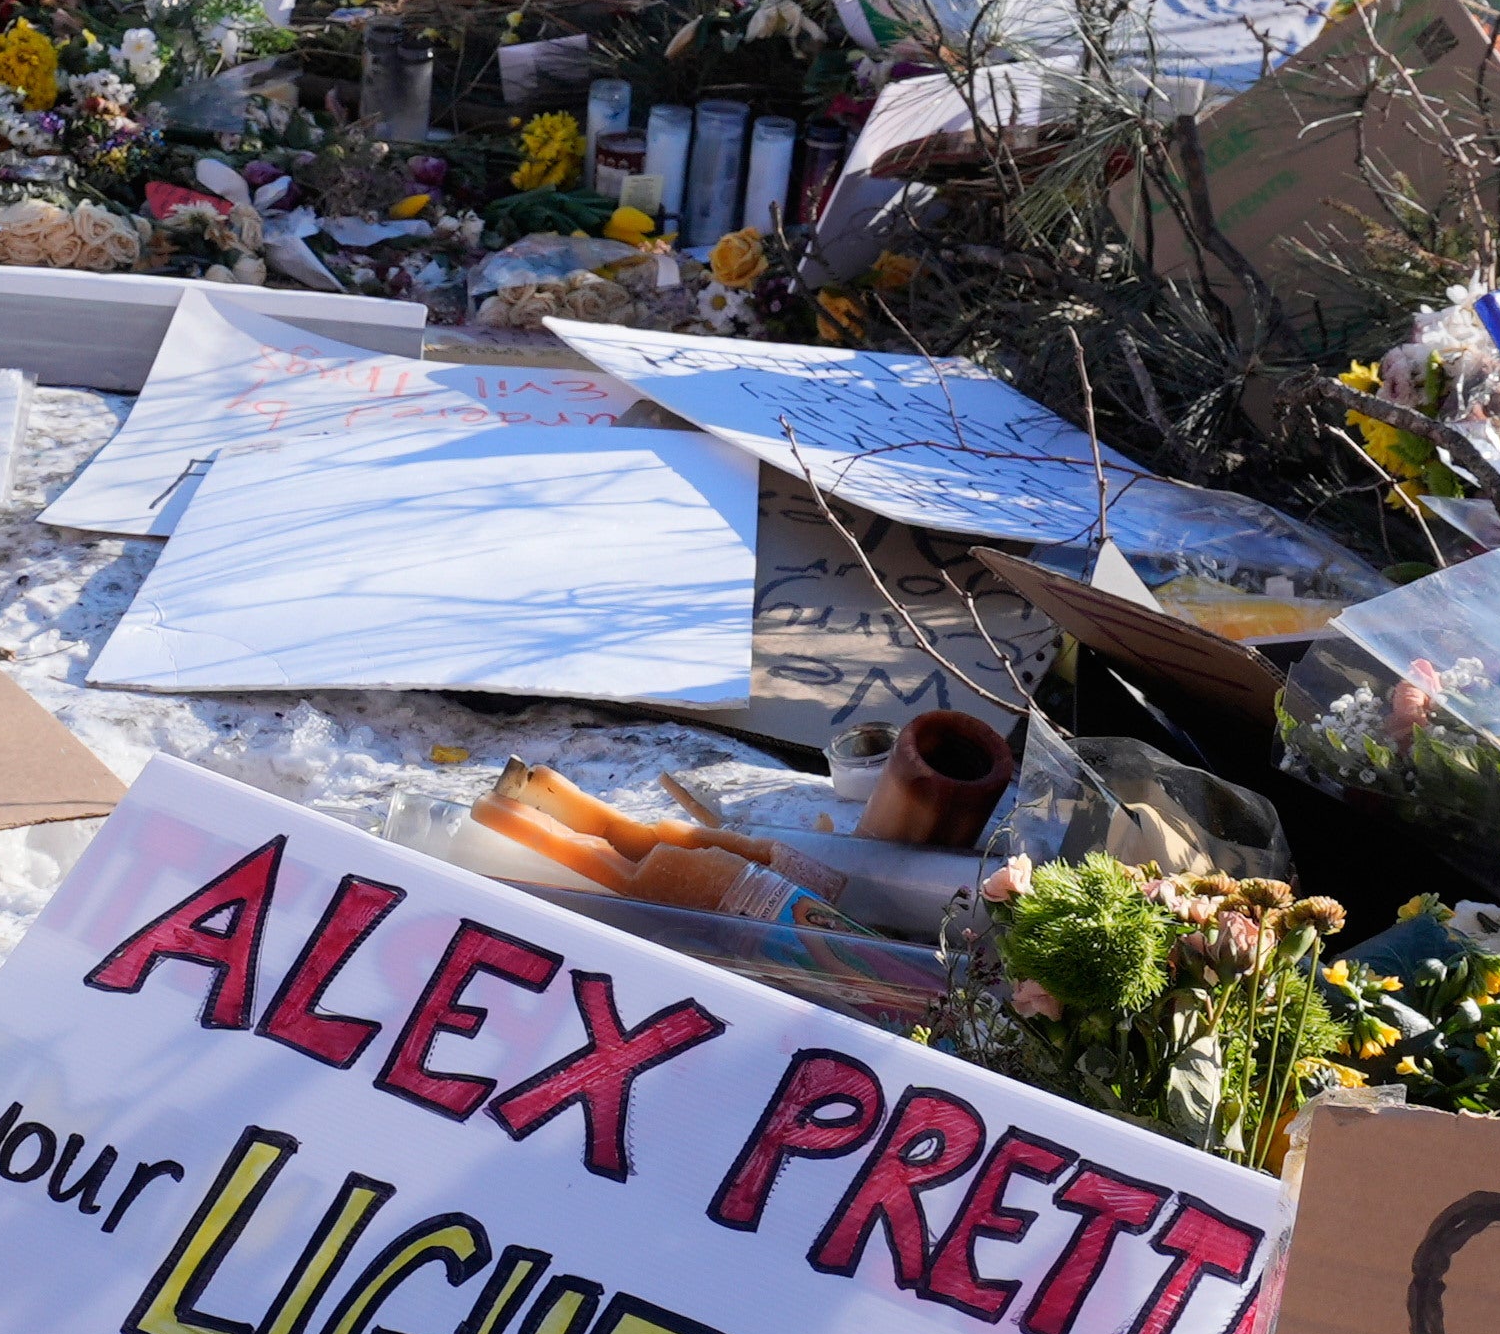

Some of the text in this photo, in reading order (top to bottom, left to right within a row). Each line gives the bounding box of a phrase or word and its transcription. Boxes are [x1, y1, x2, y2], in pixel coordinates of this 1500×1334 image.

[476, 375, 610, 402] Evil
[344, 404, 618, 429] urdered
[764, 651, 952, 726] We
[84, 832, 727, 1182] ALEX
